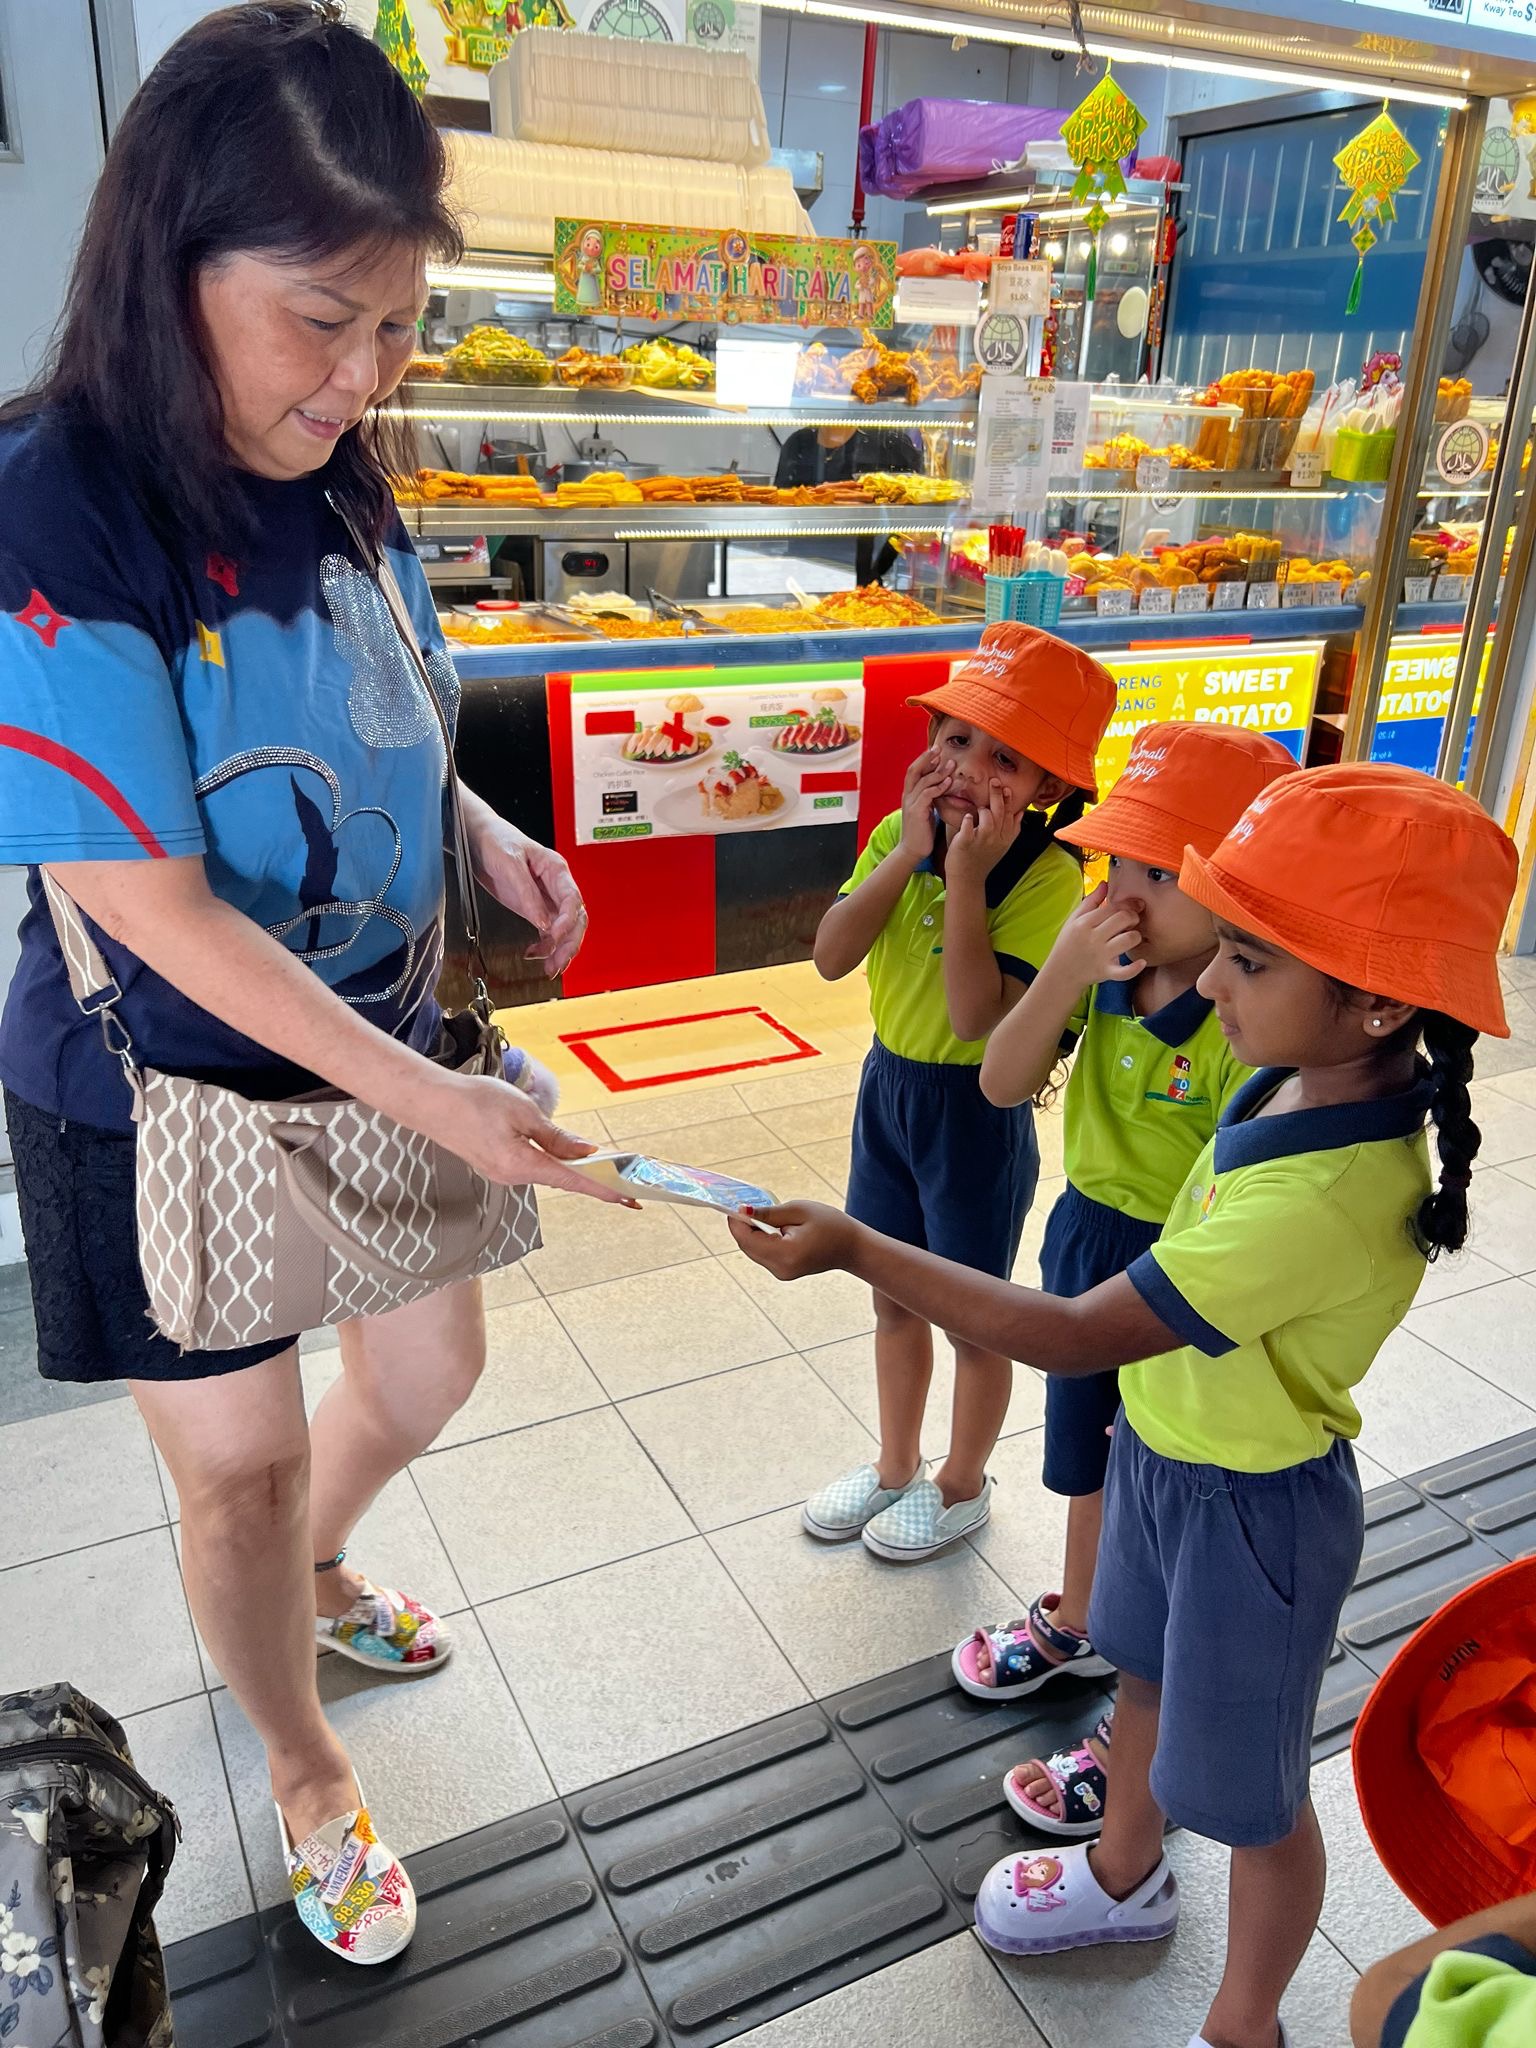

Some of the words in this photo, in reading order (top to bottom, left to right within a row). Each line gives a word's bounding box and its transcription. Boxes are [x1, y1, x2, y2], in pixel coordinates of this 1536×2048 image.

[1484, 2, 1506, 16] Kway
[1508, 6, 1523, 18] Teo
[609, 256, 724, 294] SELAMAT
[732, 263, 788, 298] HARI
[794, 265, 852, 302] RAYA
[1031, 264, 1044, 272] Milk
[1118, 675, 1162, 690] RENG
[1203, 666, 1294, 696] SWEET
[1194, 701, 1293, 727] POTATO
[1129, 761, 1160, 783] Big
[326, 1840, 358, 1899] AMERICA
[333, 1880, 376, 1924] 98-530
